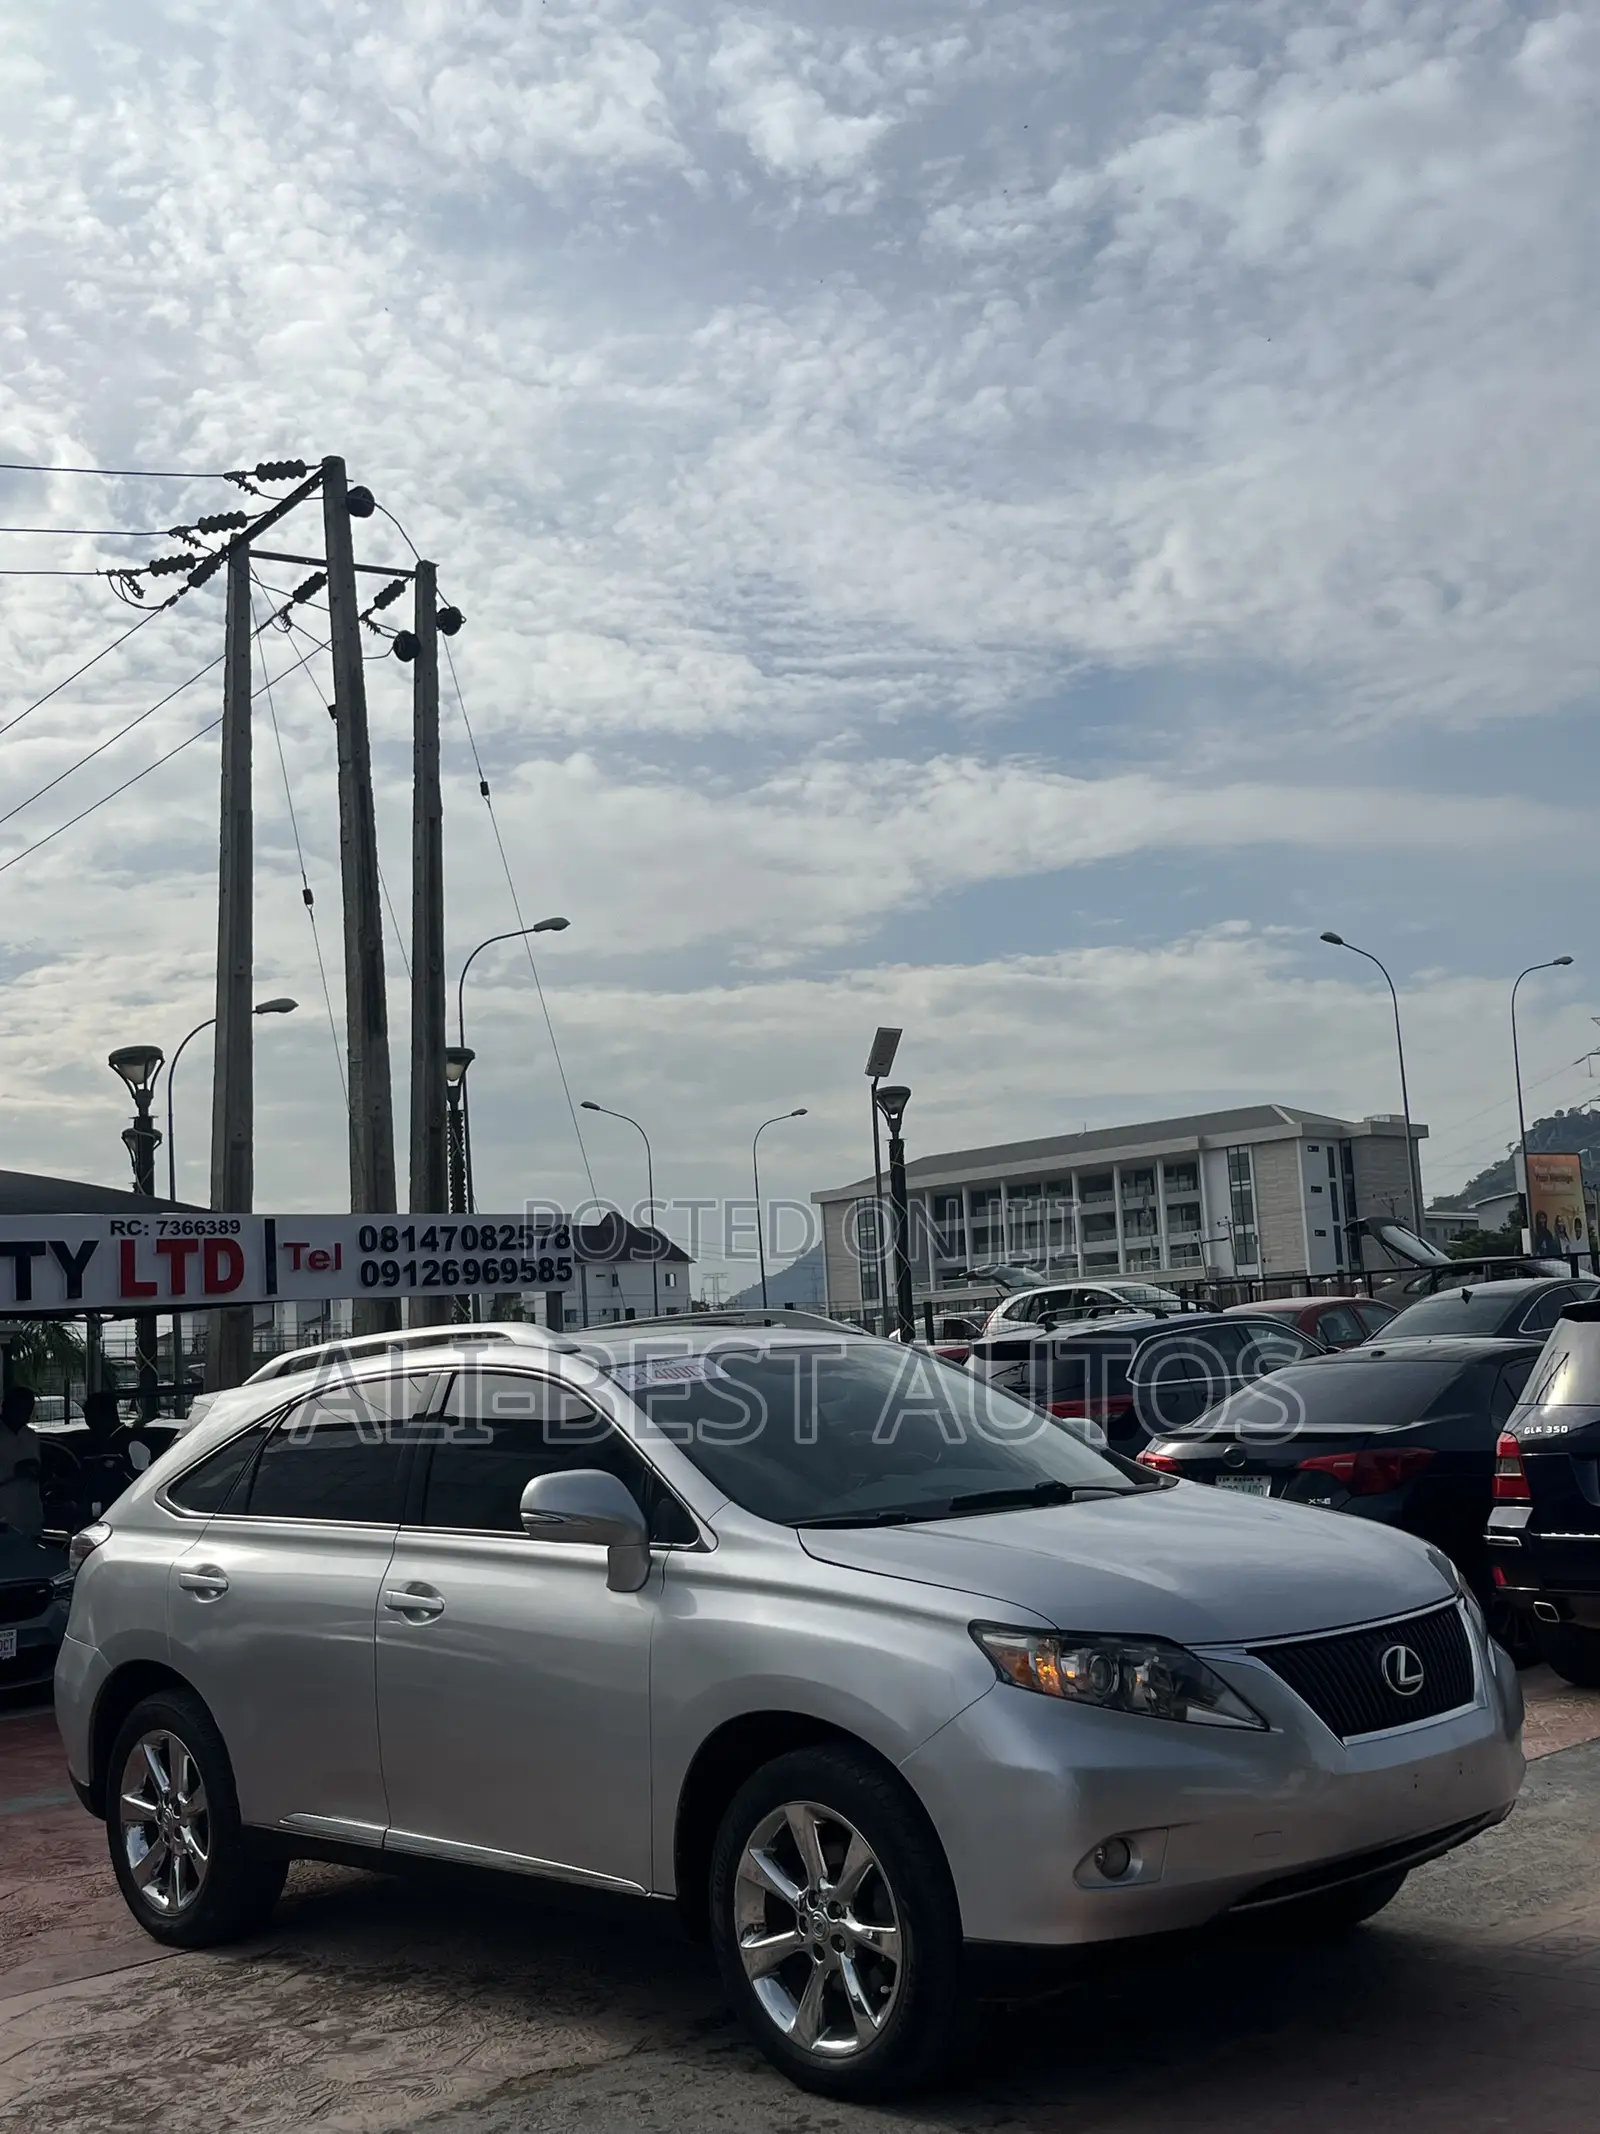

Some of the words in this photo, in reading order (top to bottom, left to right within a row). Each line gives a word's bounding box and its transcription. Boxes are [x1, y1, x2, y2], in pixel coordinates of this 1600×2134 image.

[110, 1220, 149, 1235] RC:
[155, 1219, 241, 1235] 7366389
[358, 1224, 571, 1252] 08147082578
[119, 1237, 245, 1298] LTD
[283, 1242, 342, 1271] Tel
[360, 1257, 573, 1288] 09126969585
[1523, 1425, 1543, 1435] GLK
[1545, 1424, 1569, 1434] 350
